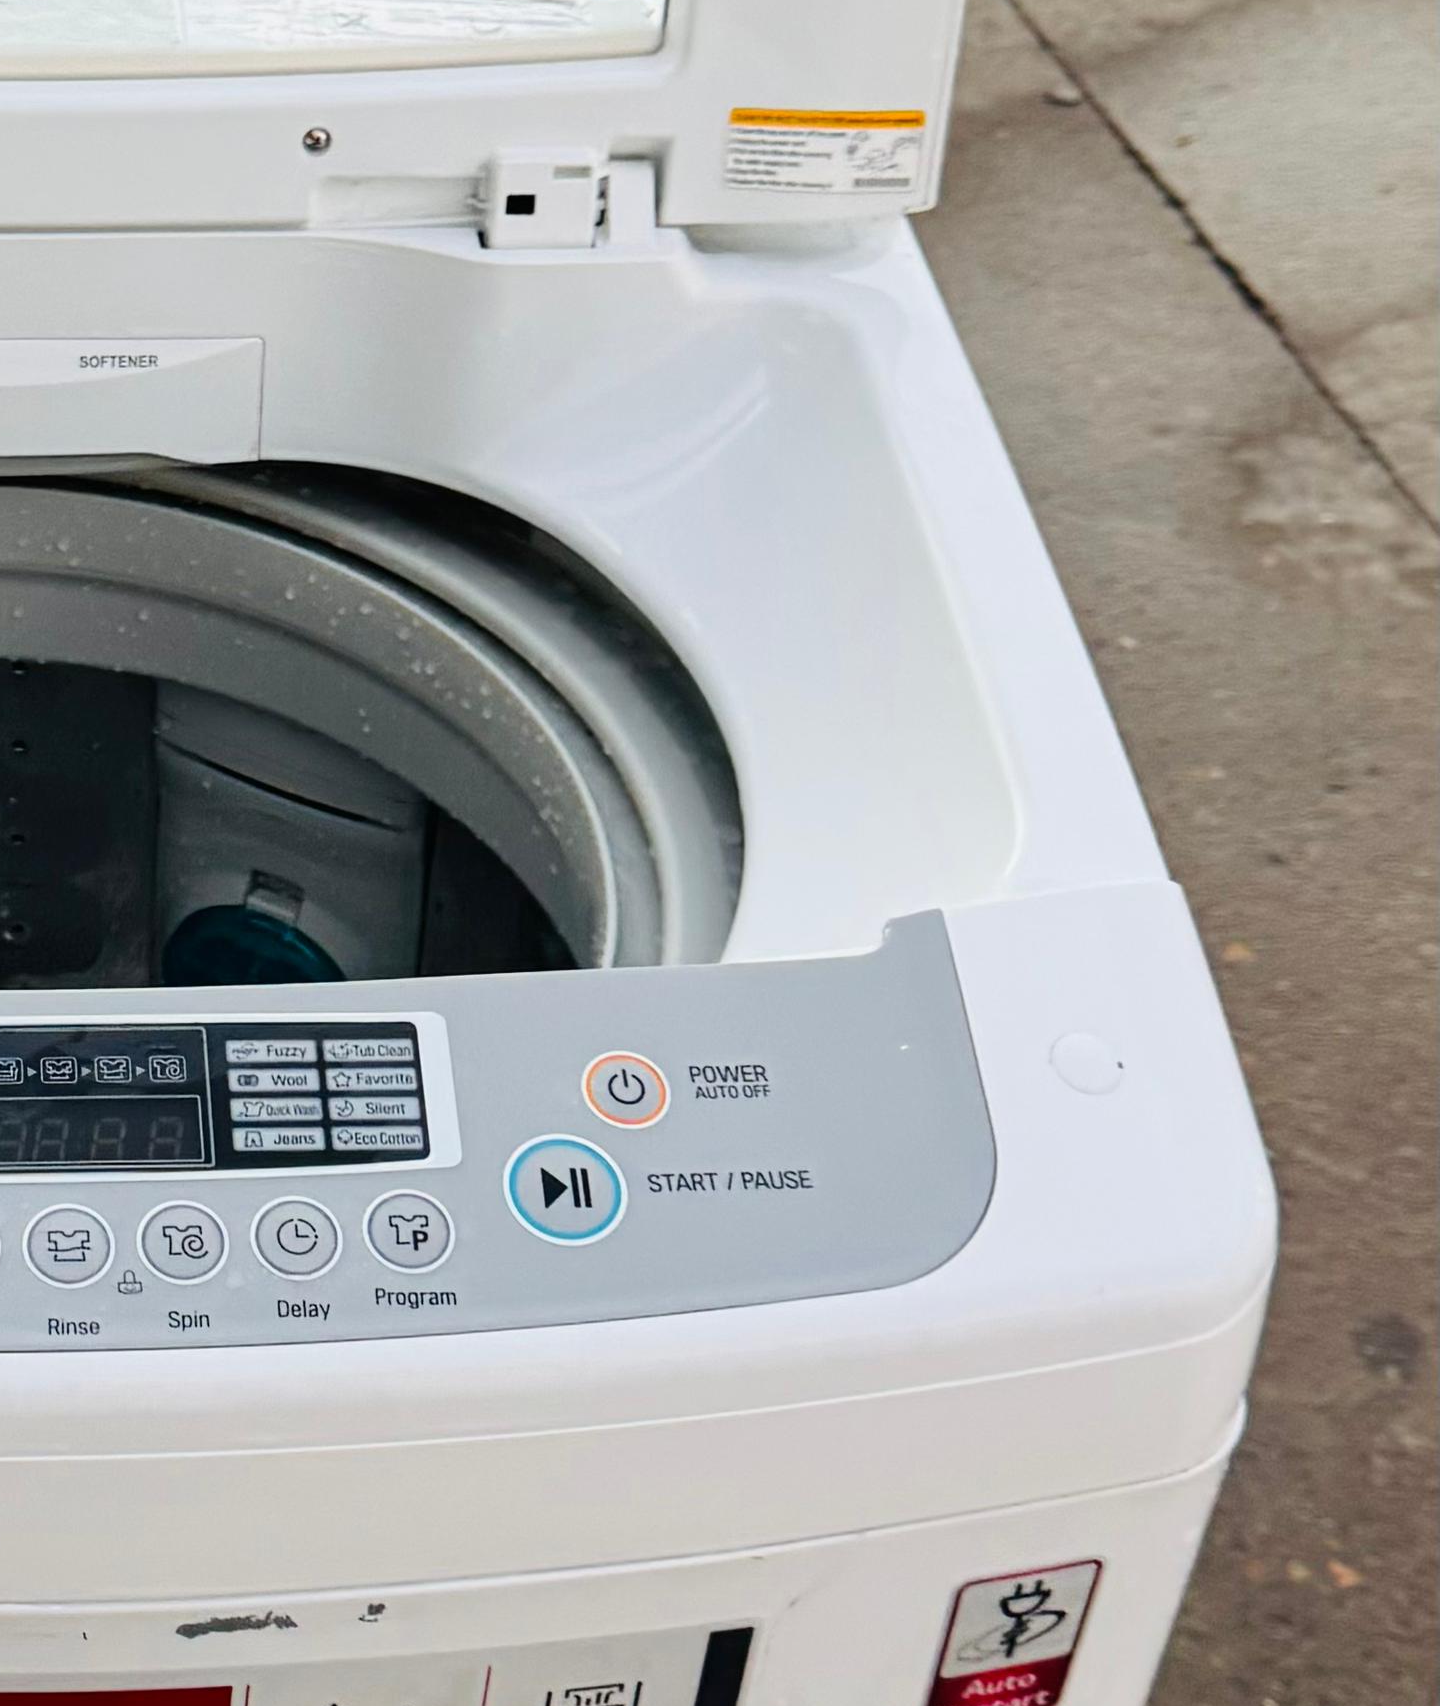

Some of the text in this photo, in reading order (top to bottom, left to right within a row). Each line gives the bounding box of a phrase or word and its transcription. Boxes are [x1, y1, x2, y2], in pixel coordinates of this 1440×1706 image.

[79, 354, 159, 369] SOFTENER
[266, 1045, 307, 1059] Fuzzy
[353, 1044, 411, 1057] Tub Clean
[271, 1074, 308, 1086] Wool
[356, 1073, 414, 1085] Favorite
[688, 1064, 769, 1084] POWER
[695, 1084, 771, 1099] AUTO OFF
[366, 1102, 405, 1115] Silent
[273, 1131, 316, 1146] Jeans
[354, 1131, 421, 1145] Eco Cotton
[647, 1172, 718, 1193] START
[741, 1170, 814, 1191] PAUSE
[375, 1287, 458, 1309] Program
[276, 1299, 331, 1322] Delay
[47, 1317, 101, 1336] Rinse
[167, 1310, 211, 1332] Spin
[961, 1673, 1037, 1699] Auto
